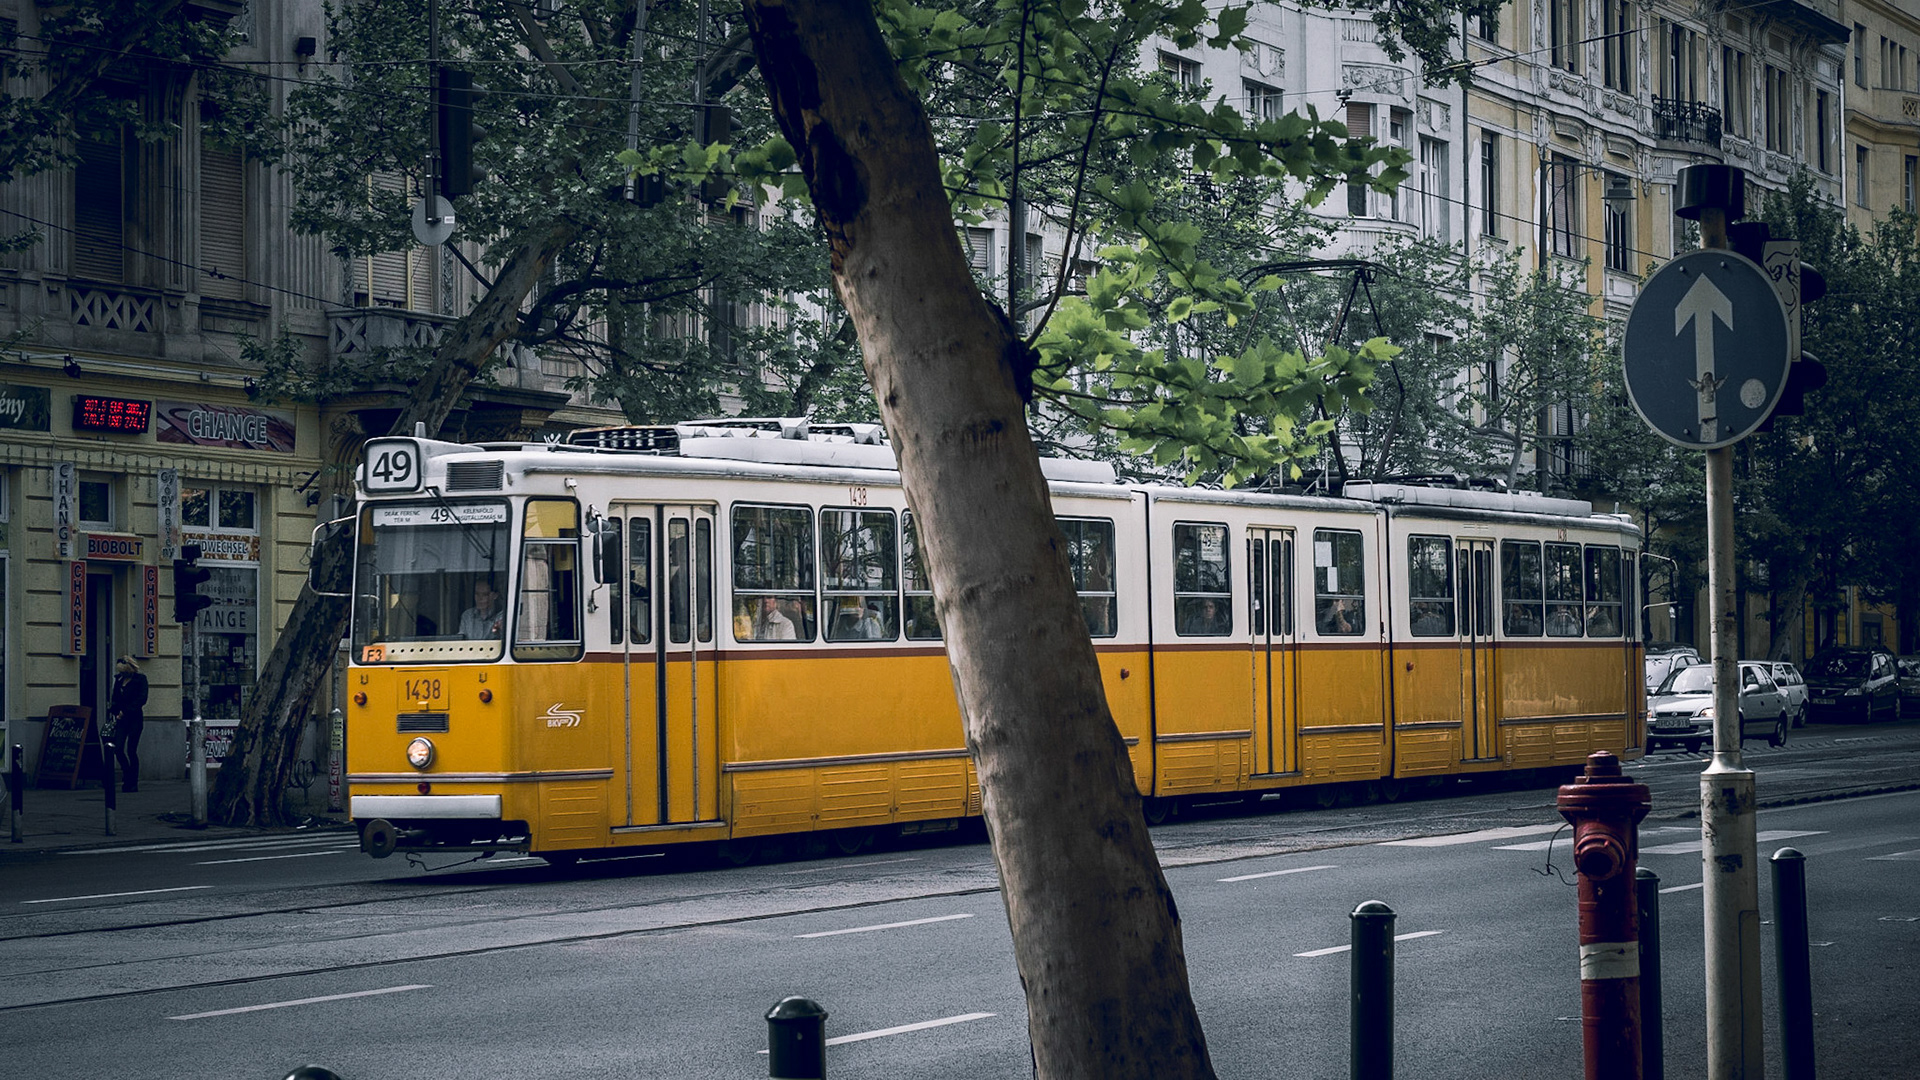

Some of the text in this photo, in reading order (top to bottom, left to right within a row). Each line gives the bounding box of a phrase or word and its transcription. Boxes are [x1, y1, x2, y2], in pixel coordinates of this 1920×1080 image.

[188, 409, 268, 444] CHANGE
[372, 450, 412, 483] 49
[848, 487, 868, 506] 1438
[59, 464, 68, 555] CHANGE
[431, 507, 450, 523] 49
[88, 539, 142, 556] BIOBOLT
[74, 564, 82, 652] CHANGE
[147, 569, 155, 654] CHANGE
[183, 610, 247, 628] ANGE
[366, 649, 383, 662] F3
[405, 678, 441, 701] 1438
